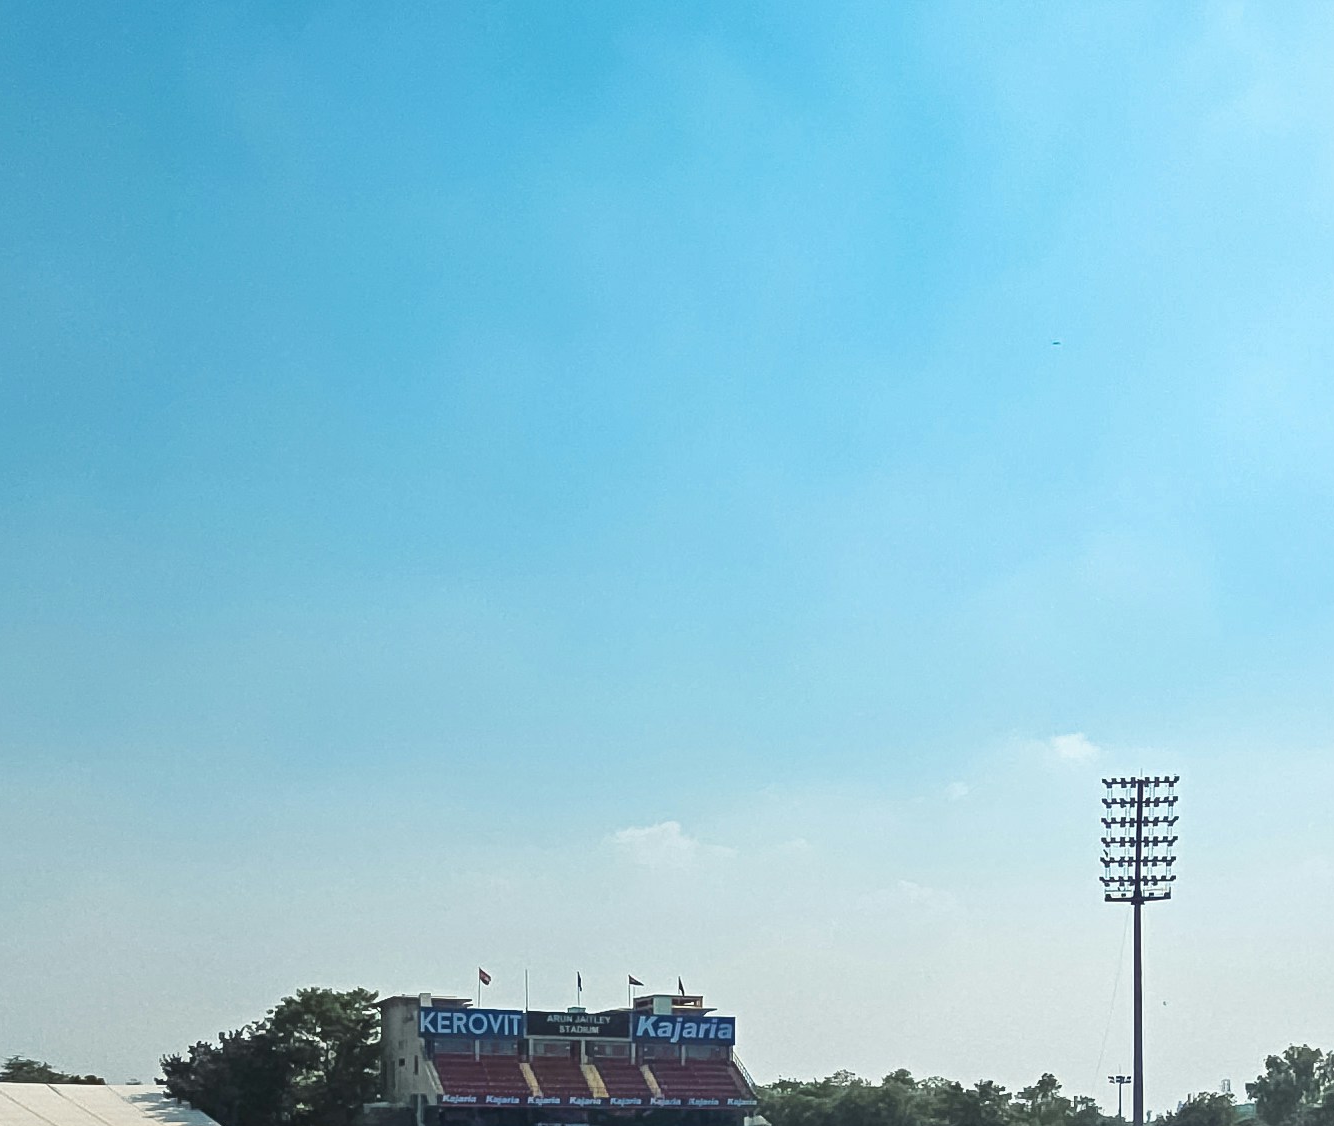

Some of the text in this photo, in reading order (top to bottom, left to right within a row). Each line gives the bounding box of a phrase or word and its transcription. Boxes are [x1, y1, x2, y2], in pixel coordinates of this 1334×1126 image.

[419, 1012, 522, 1035] KEROVIT
[547, 1014, 611, 1025] ARUN JAITLEY
[559, 1025, 600, 1034] STADIUM
[635, 1014, 733, 1044] Kajaria
